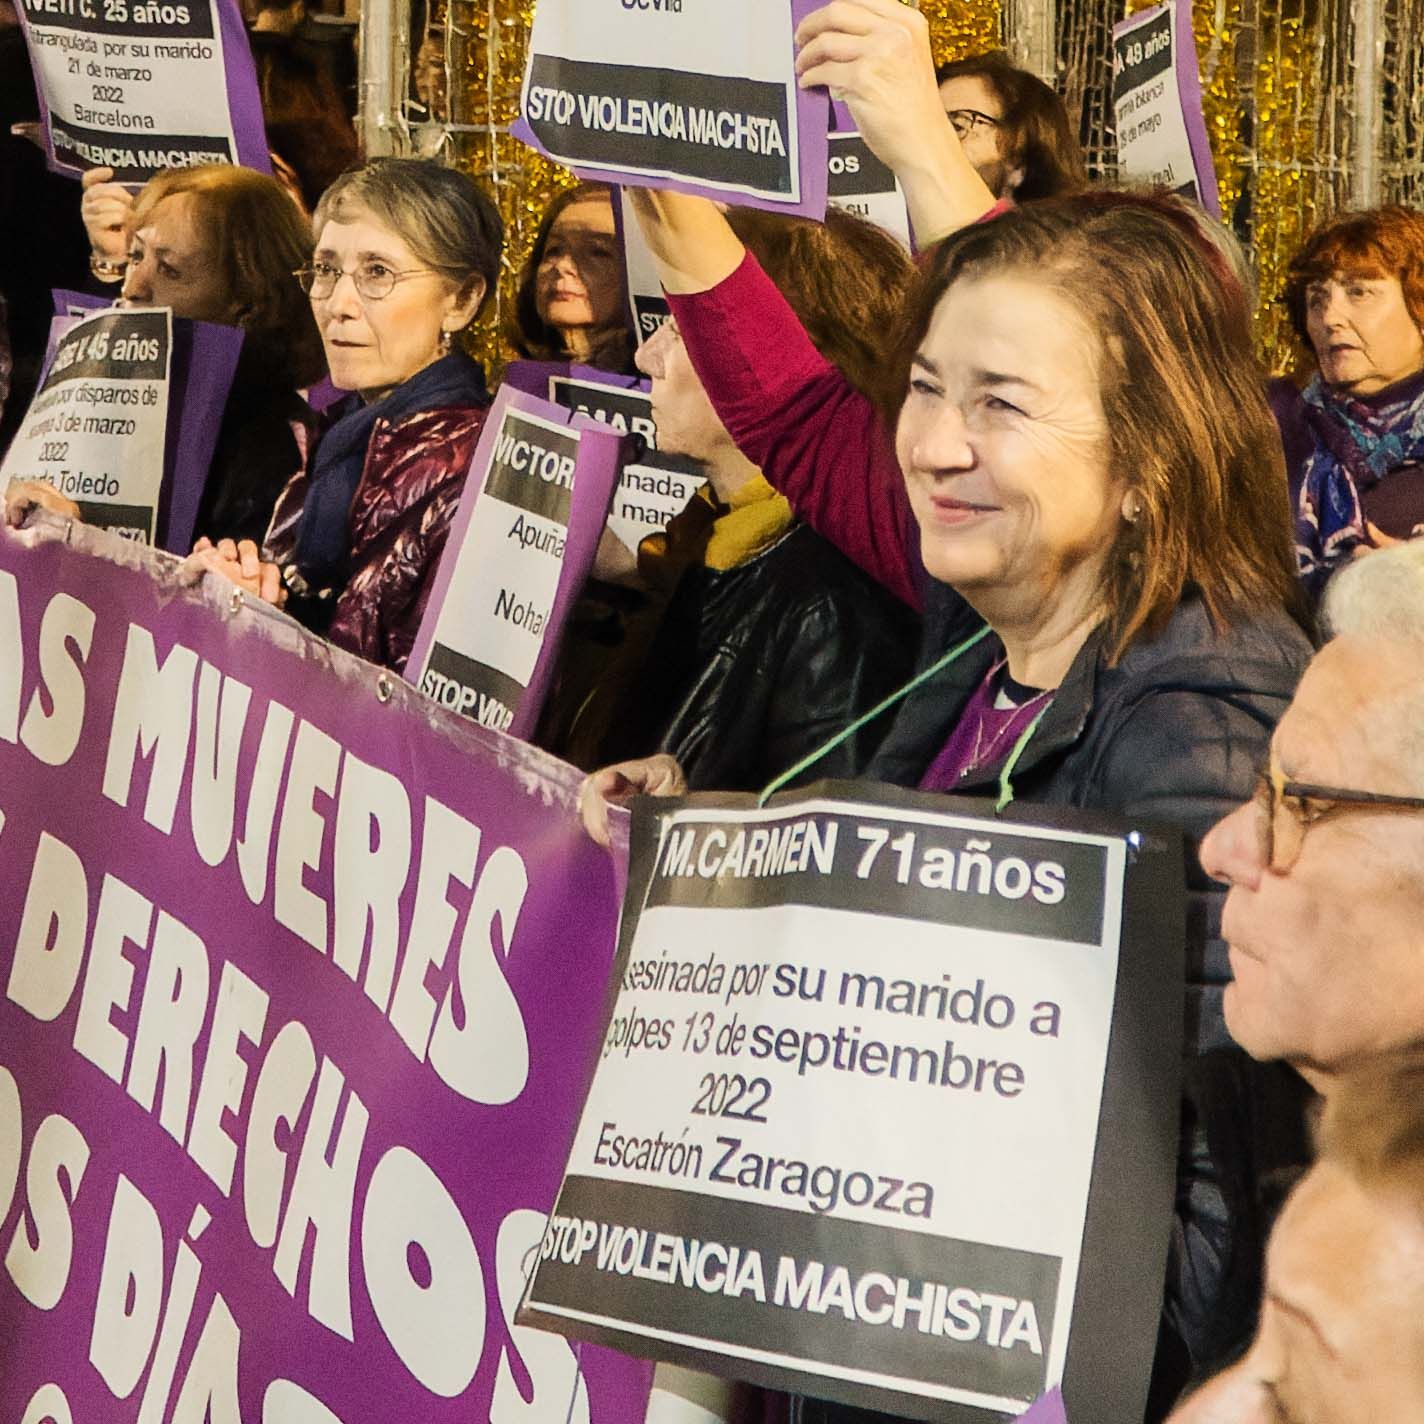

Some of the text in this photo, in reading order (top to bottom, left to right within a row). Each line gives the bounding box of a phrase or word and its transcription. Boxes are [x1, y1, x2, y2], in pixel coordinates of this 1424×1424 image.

[133, 1, 191, 25] años
[86, 59, 102, 78] de
[104, 66, 152, 81] marzo
[103, 41, 213, 60] por su marido
[74, 103, 155, 129] Barcelona
[92, 84, 124, 104] 2022
[529, 86, 575, 126] STOP
[578, 94, 686, 140] VIOLENCIA
[111, 332, 159, 362] años
[75, 381, 139, 406] disparos
[142, 384, 158, 406] de
[66, 415, 81, 434] de
[82, 417, 136, 436] marzo
[38, 441, 69, 462] 2022
[494, 434, 575, 492] VICTOR
[58, 470, 120, 497] Toledo
[420, 668, 476, 714] STOP
[101, 622, 530, 1106] MUJERES
[725, 964, 771, 1007] por
[772, 961, 824, 1000] su
[838, 971, 1016, 1030] marido
[1029, 1001, 1062, 1038] a
[682, 1011, 715, 1053] 13
[715, 1012, 747, 1057] de
[749, 1023, 1026, 1099] septiembre
[691, 1073, 774, 1125] 2022
[6, 830, 590, 1424] DERECHOS
[593, 1120, 935, 1221] Escatrón Zaragoza
[88, 1172, 348, 1424] DÍA
[542, 1216, 1043, 1356] STOP VIOLENCIA MACHISTA
